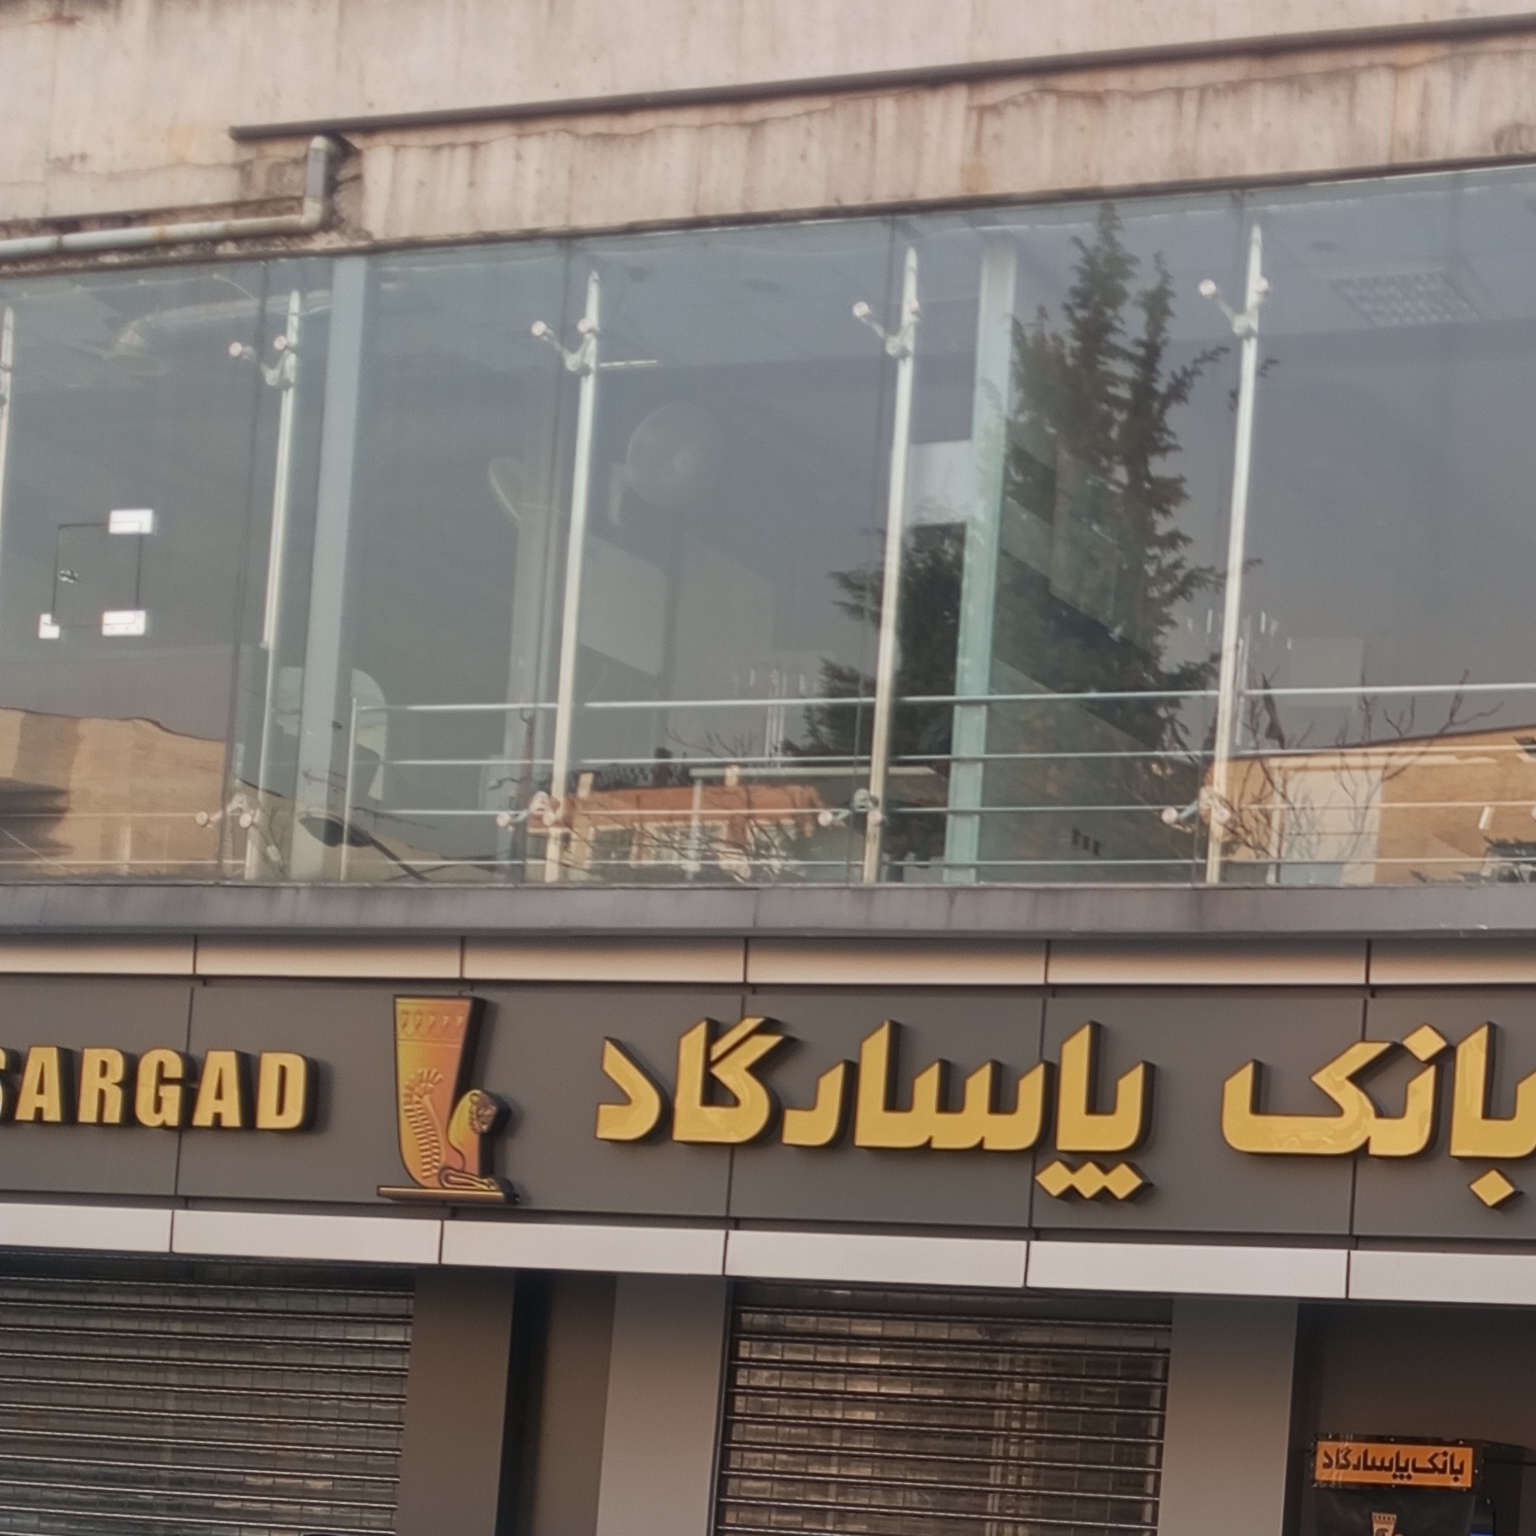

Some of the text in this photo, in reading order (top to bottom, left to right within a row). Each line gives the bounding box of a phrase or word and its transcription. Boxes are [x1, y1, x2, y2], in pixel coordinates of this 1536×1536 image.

[0, 1045, 312, 1130] ARGAD
[594, 1015, 1152, 1200] پاسارگاد
[1322, 1446, 1465, 1482] بانک پاسارگاد
